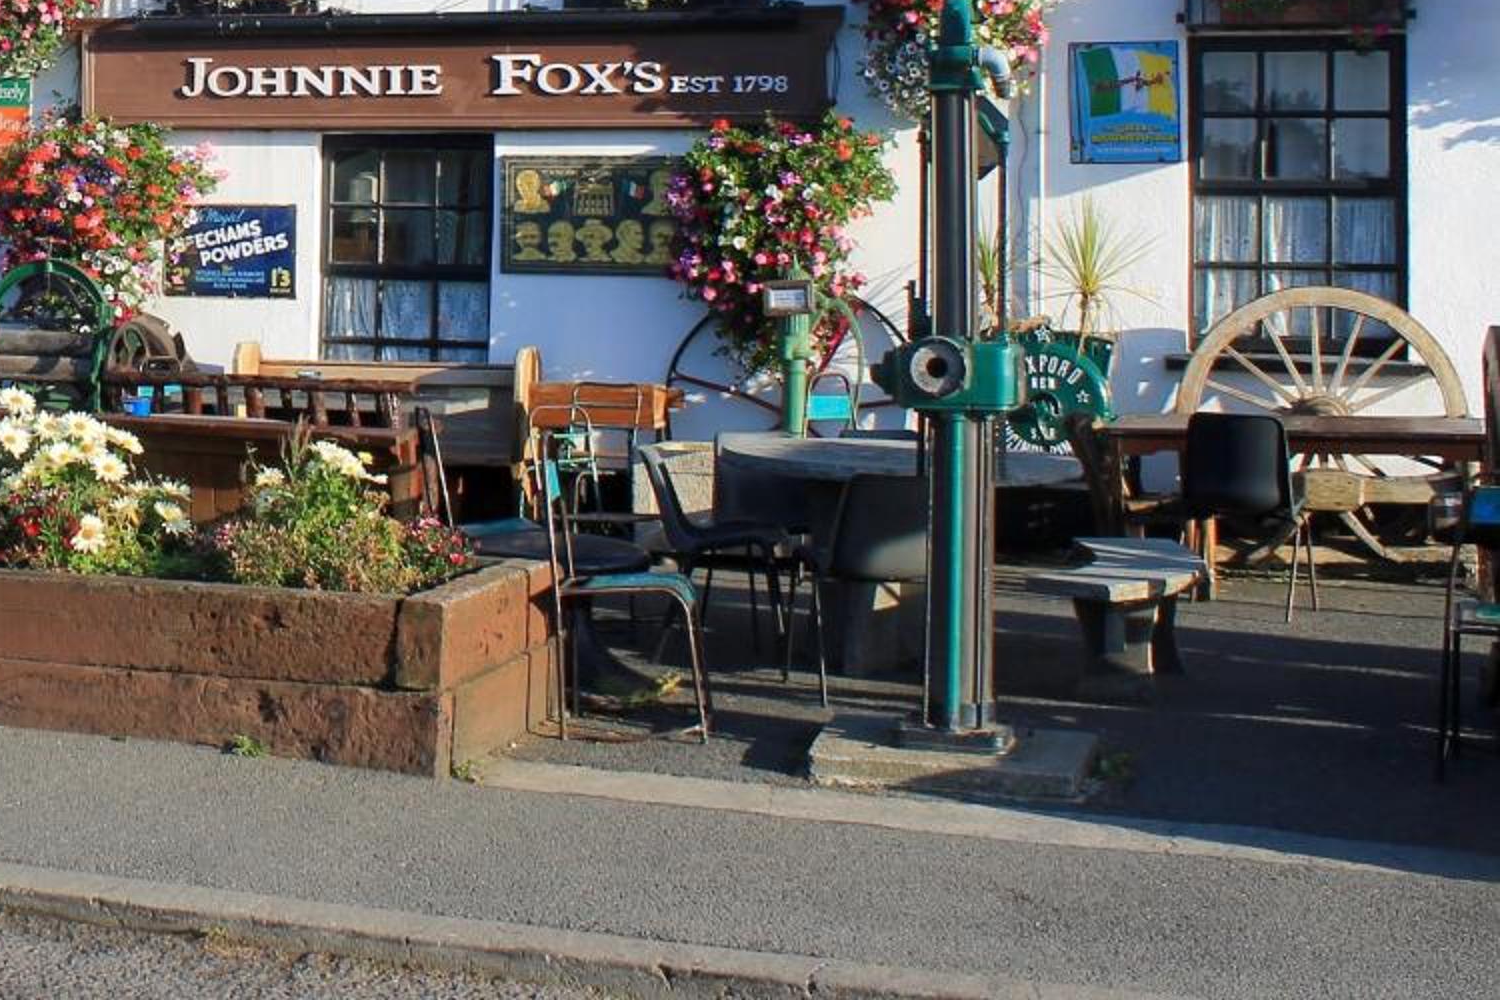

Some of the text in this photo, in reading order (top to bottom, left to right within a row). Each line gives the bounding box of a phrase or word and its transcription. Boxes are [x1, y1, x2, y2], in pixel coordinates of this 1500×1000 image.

[181, 53, 789, 97] JOHNNIE FOX'S EST 1798
[187, 219, 263, 250] ECHAMS
[199, 233, 289, 267] POWDERS
[1025, 354, 1083, 385] XFORD
